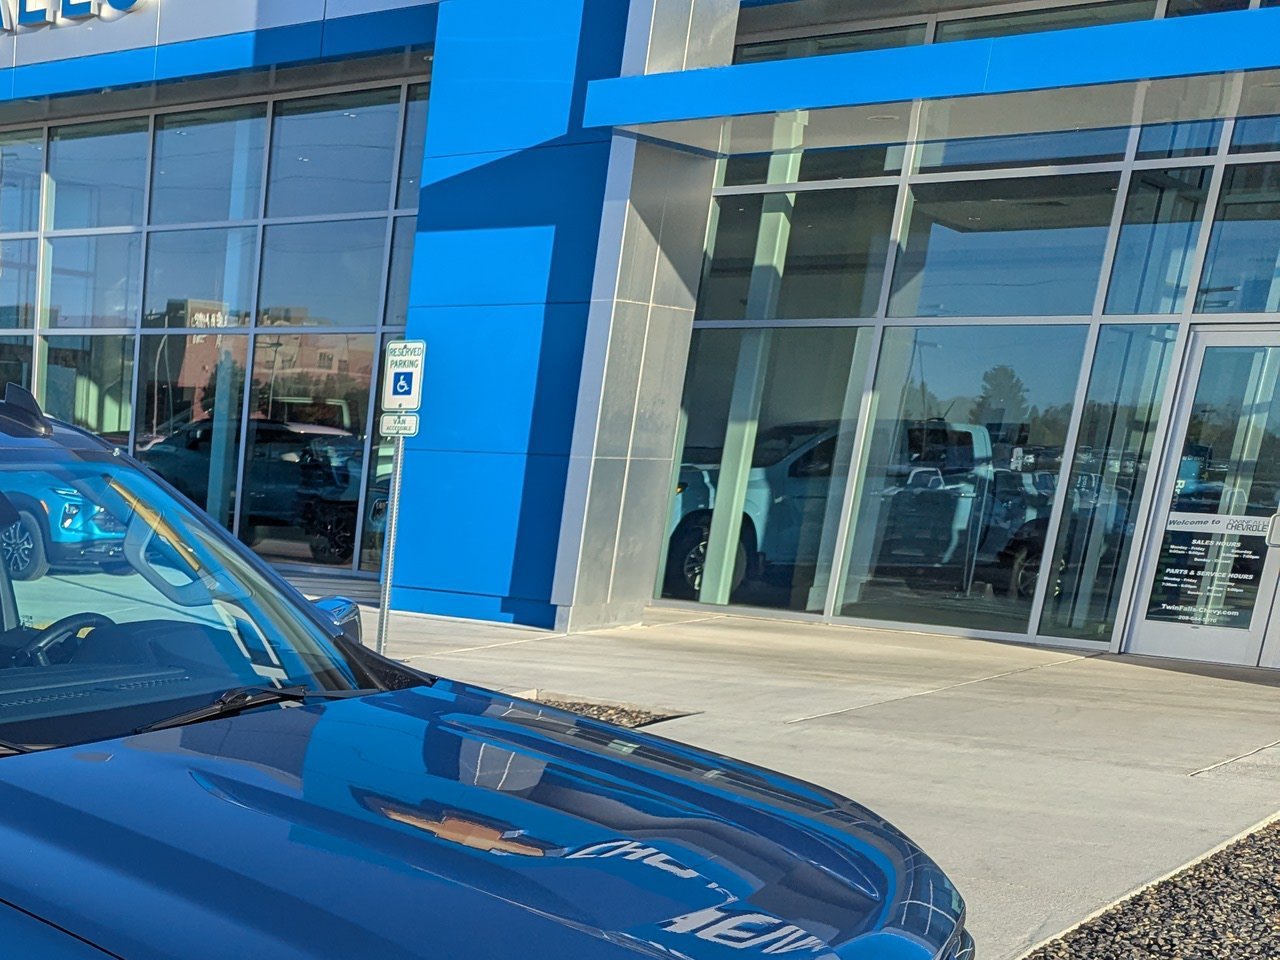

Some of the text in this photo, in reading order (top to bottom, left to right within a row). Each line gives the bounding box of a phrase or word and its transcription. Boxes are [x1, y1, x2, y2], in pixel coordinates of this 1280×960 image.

[389, 347, 422, 357] RESERVED
[389, 359, 419, 369] PARKING
[1225, 522, 1270, 532] CHEVROLE
[1165, 567, 1188, 575] PARTS
[1196, 570, 1227, 578] SERVICE
[1227, 572, 1254, 580] HOURS
